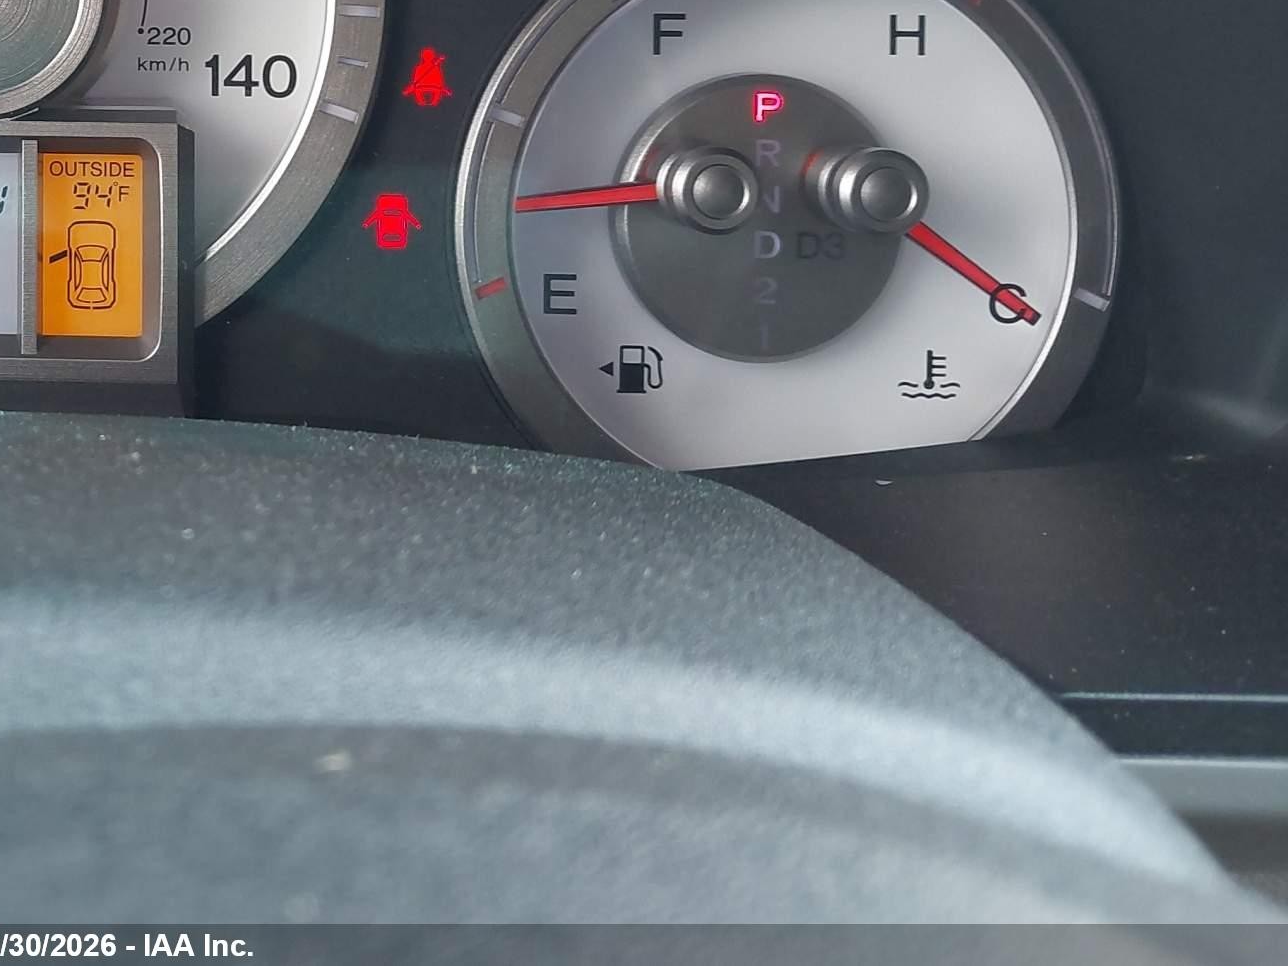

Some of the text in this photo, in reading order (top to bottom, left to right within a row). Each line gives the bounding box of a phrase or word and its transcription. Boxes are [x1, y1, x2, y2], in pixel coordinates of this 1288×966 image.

[147, 27, 191, 46] 220
[653, 13, 686, 55] F
[890, 14, 925, 55] H
[137, 56, 189, 73] km/h
[205, 54, 297, 98] 140
[754, 93, 783, 121] P
[757, 140, 780, 166] R
[50, 161, 134, 178] OUTSIDE
[757, 233, 780, 258] D
[543, 274, 577, 315] E
[989, 283, 1027, 324] C
